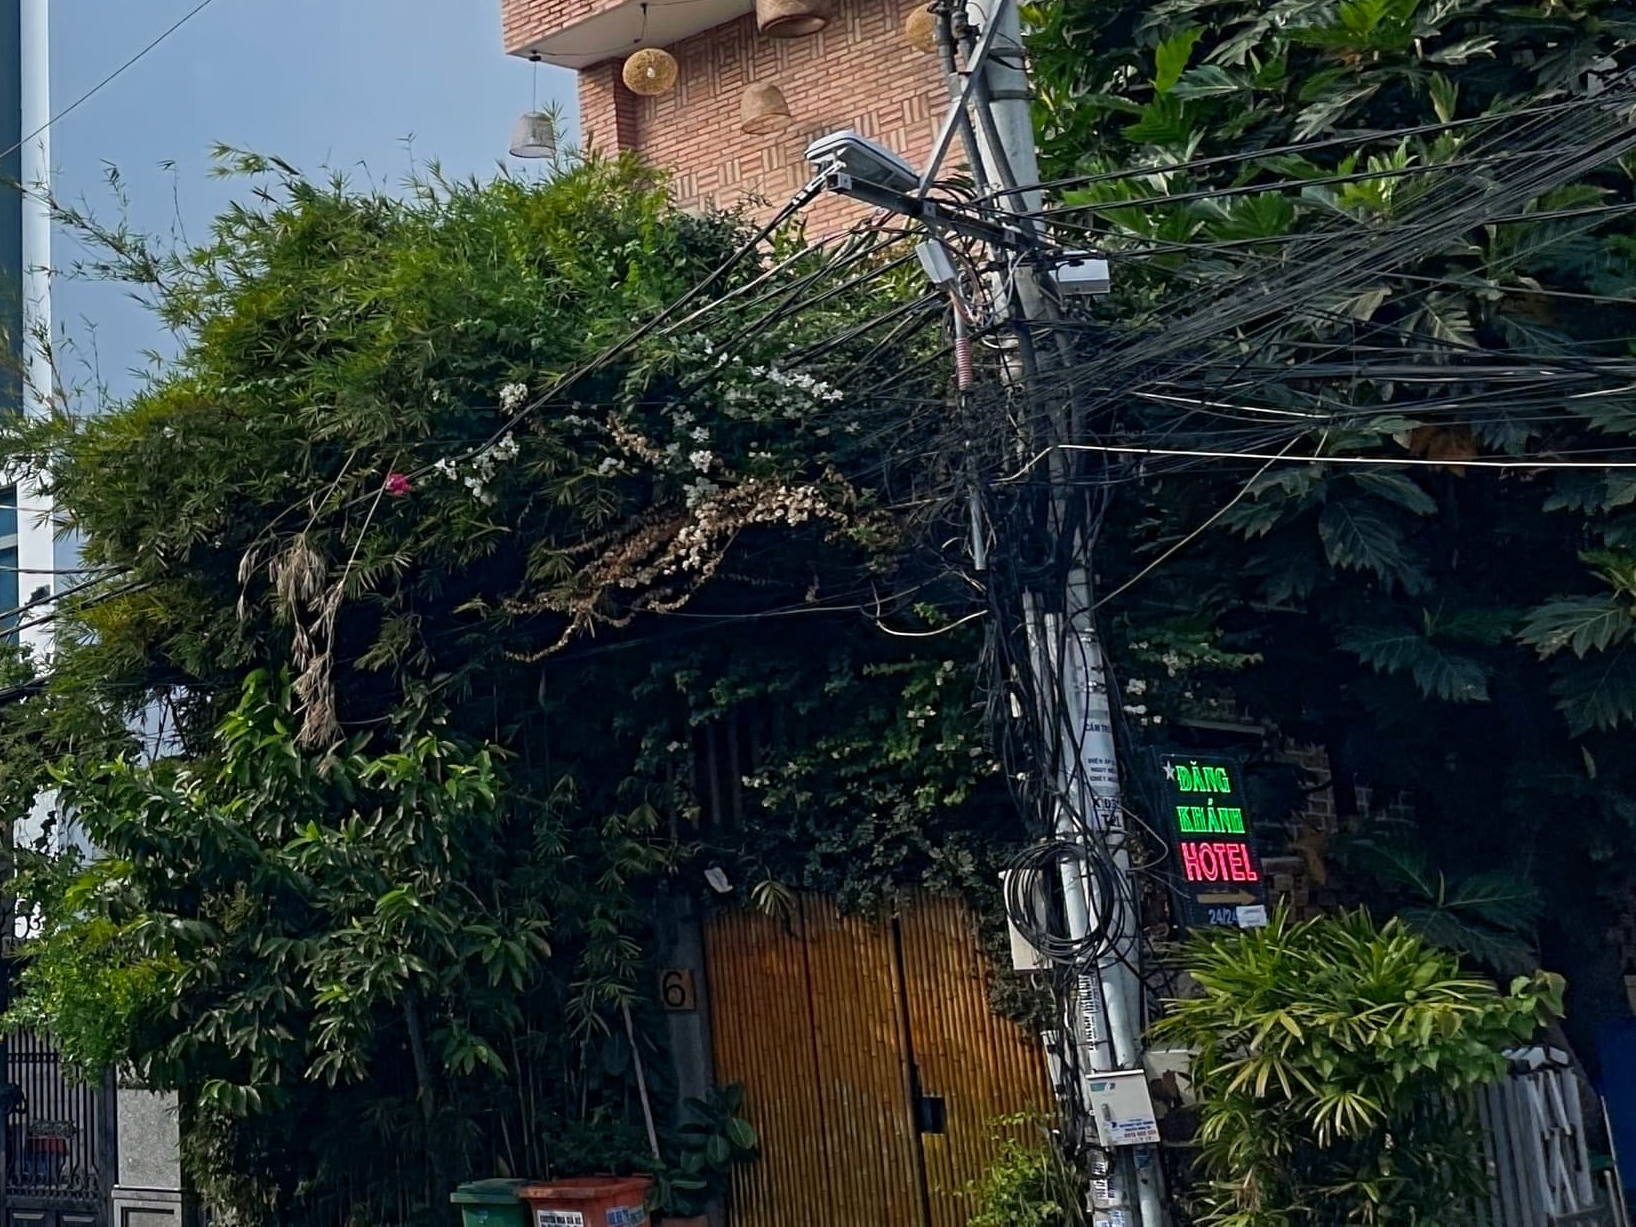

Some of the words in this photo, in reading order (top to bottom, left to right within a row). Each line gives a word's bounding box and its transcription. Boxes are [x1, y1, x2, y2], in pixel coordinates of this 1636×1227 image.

[1175, 760, 1231, 793] ĐĂNG
[1176, 798, 1246, 834] KHÁNH
[662, 971, 686, 1007] 6
